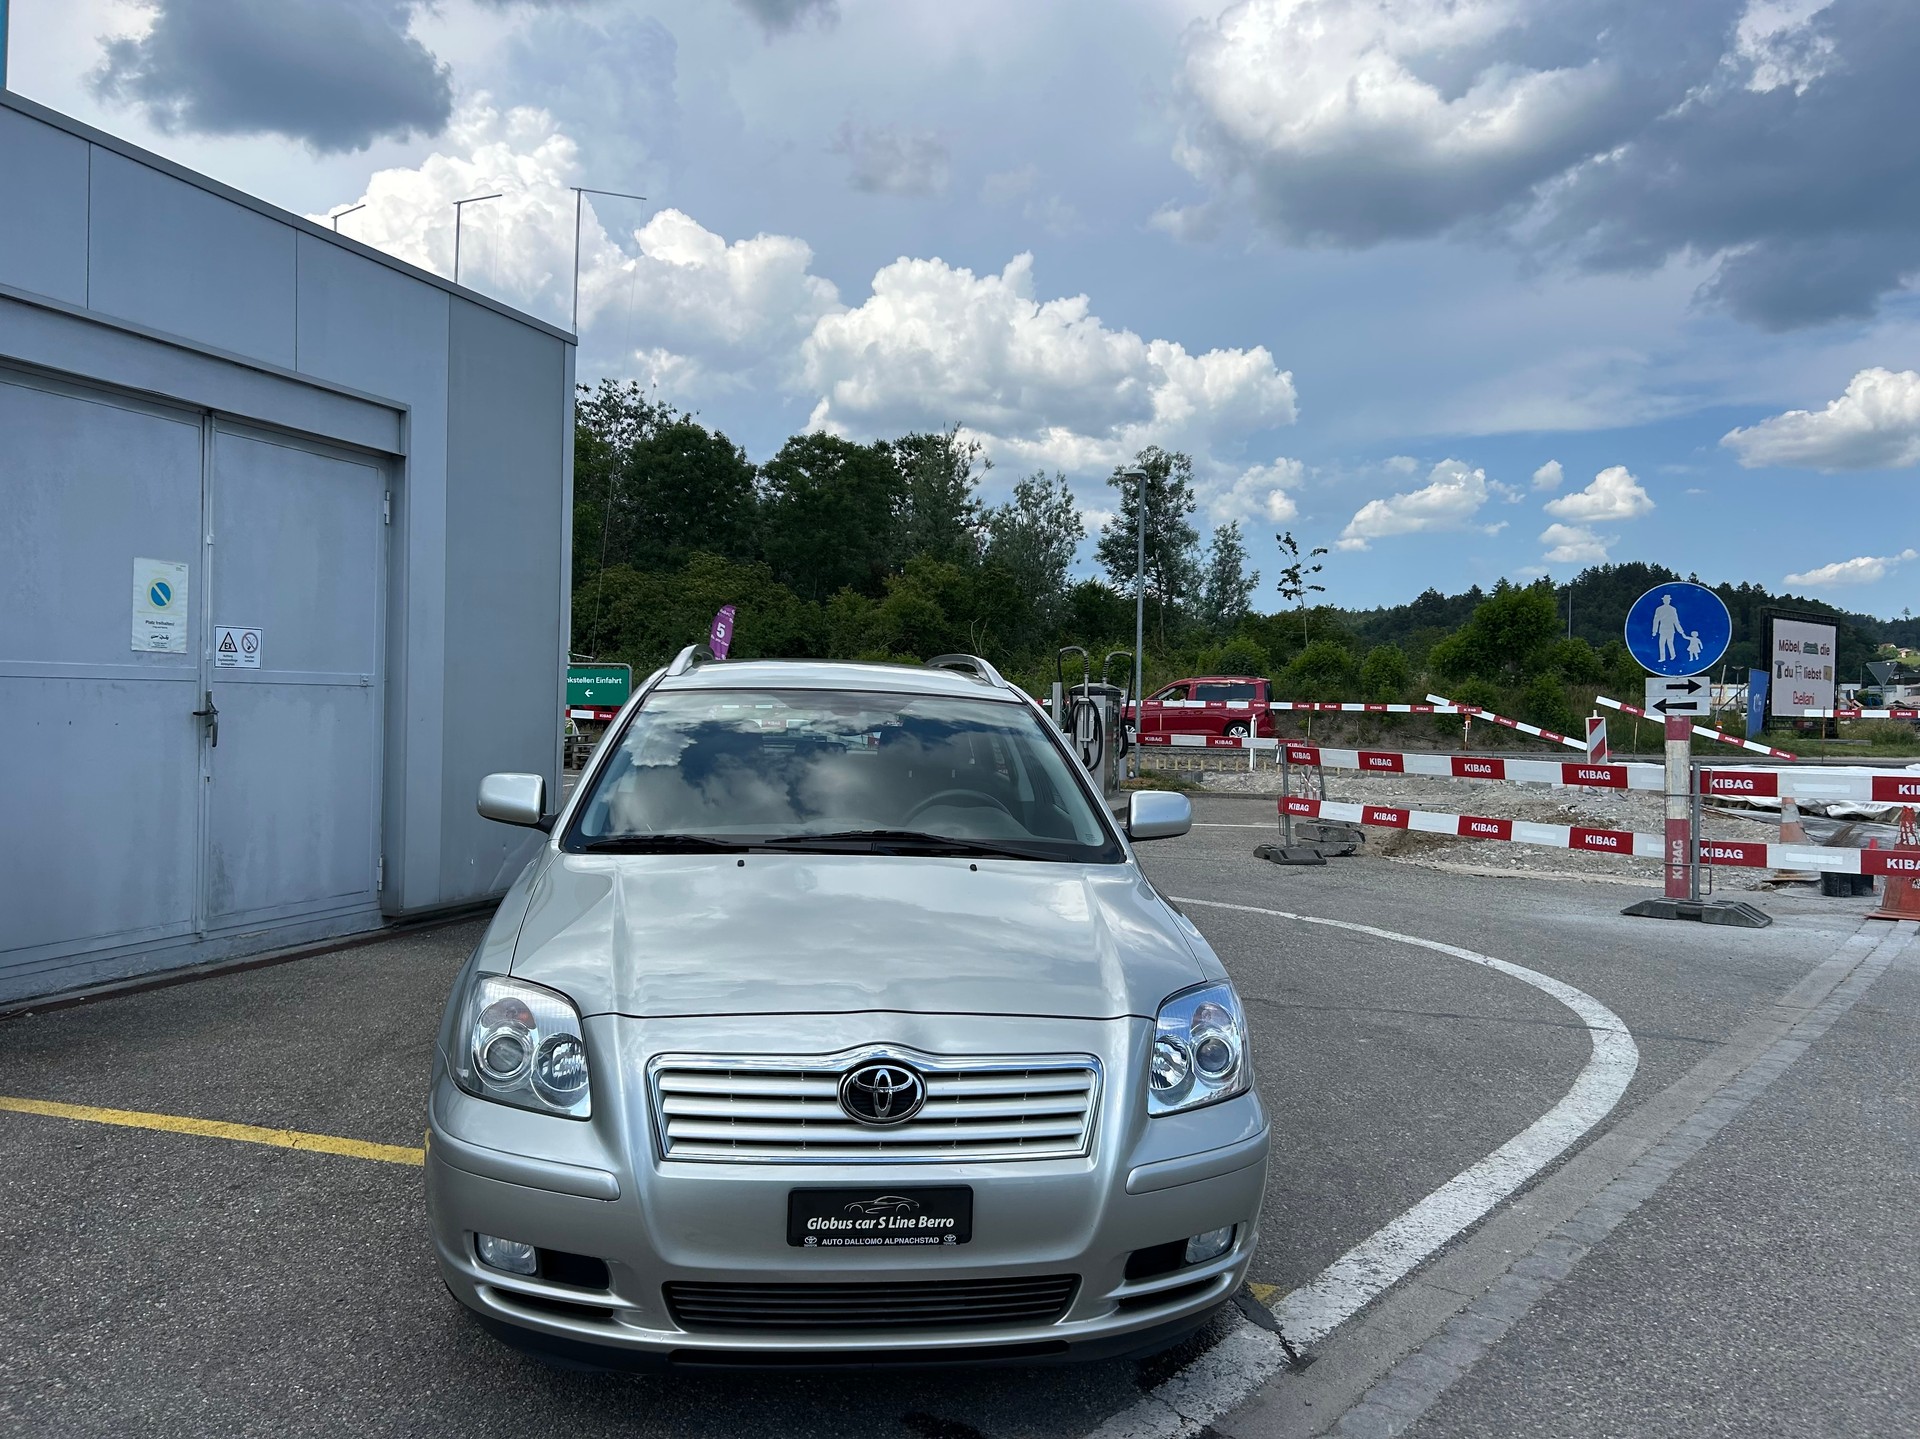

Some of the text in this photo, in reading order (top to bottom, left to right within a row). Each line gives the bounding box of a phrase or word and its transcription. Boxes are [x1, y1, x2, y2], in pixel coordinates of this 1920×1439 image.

[716, 622, 726, 639] 5
[224, 642, 233, 650] EX
[1778, 639, 1830, 656] Möbel, die
[1784, 666, 1822, 680] du liebst
[595, 676, 622, 684] Einfahrt
[1292, 751, 1311, 760] KIBAG
[1369, 757, 1392, 768] KIBAG
[1464, 763, 1492, 774] KIBAG
[1578, 769, 1611, 781] KIBAG
[1711, 778, 1754, 790] KIBAG
[1898, 784, 1920, 795] KI
[1288, 802, 1310, 812] KIBAG
[1373, 811, 1397, 822] KIBAG
[1471, 822, 1499, 834] KIBAG
[1585, 834, 1617, 847] KIBAG
[1700, 847, 1744, 859] KIBAG
[1672, 839, 1684, 880] KIBAG
[807, 1216, 955, 1230] Globus car S Line Berro
[844, 1237, 883, 1245] DALL'OMO
[884, 1236, 940, 1245] ALPNACHSTAD
